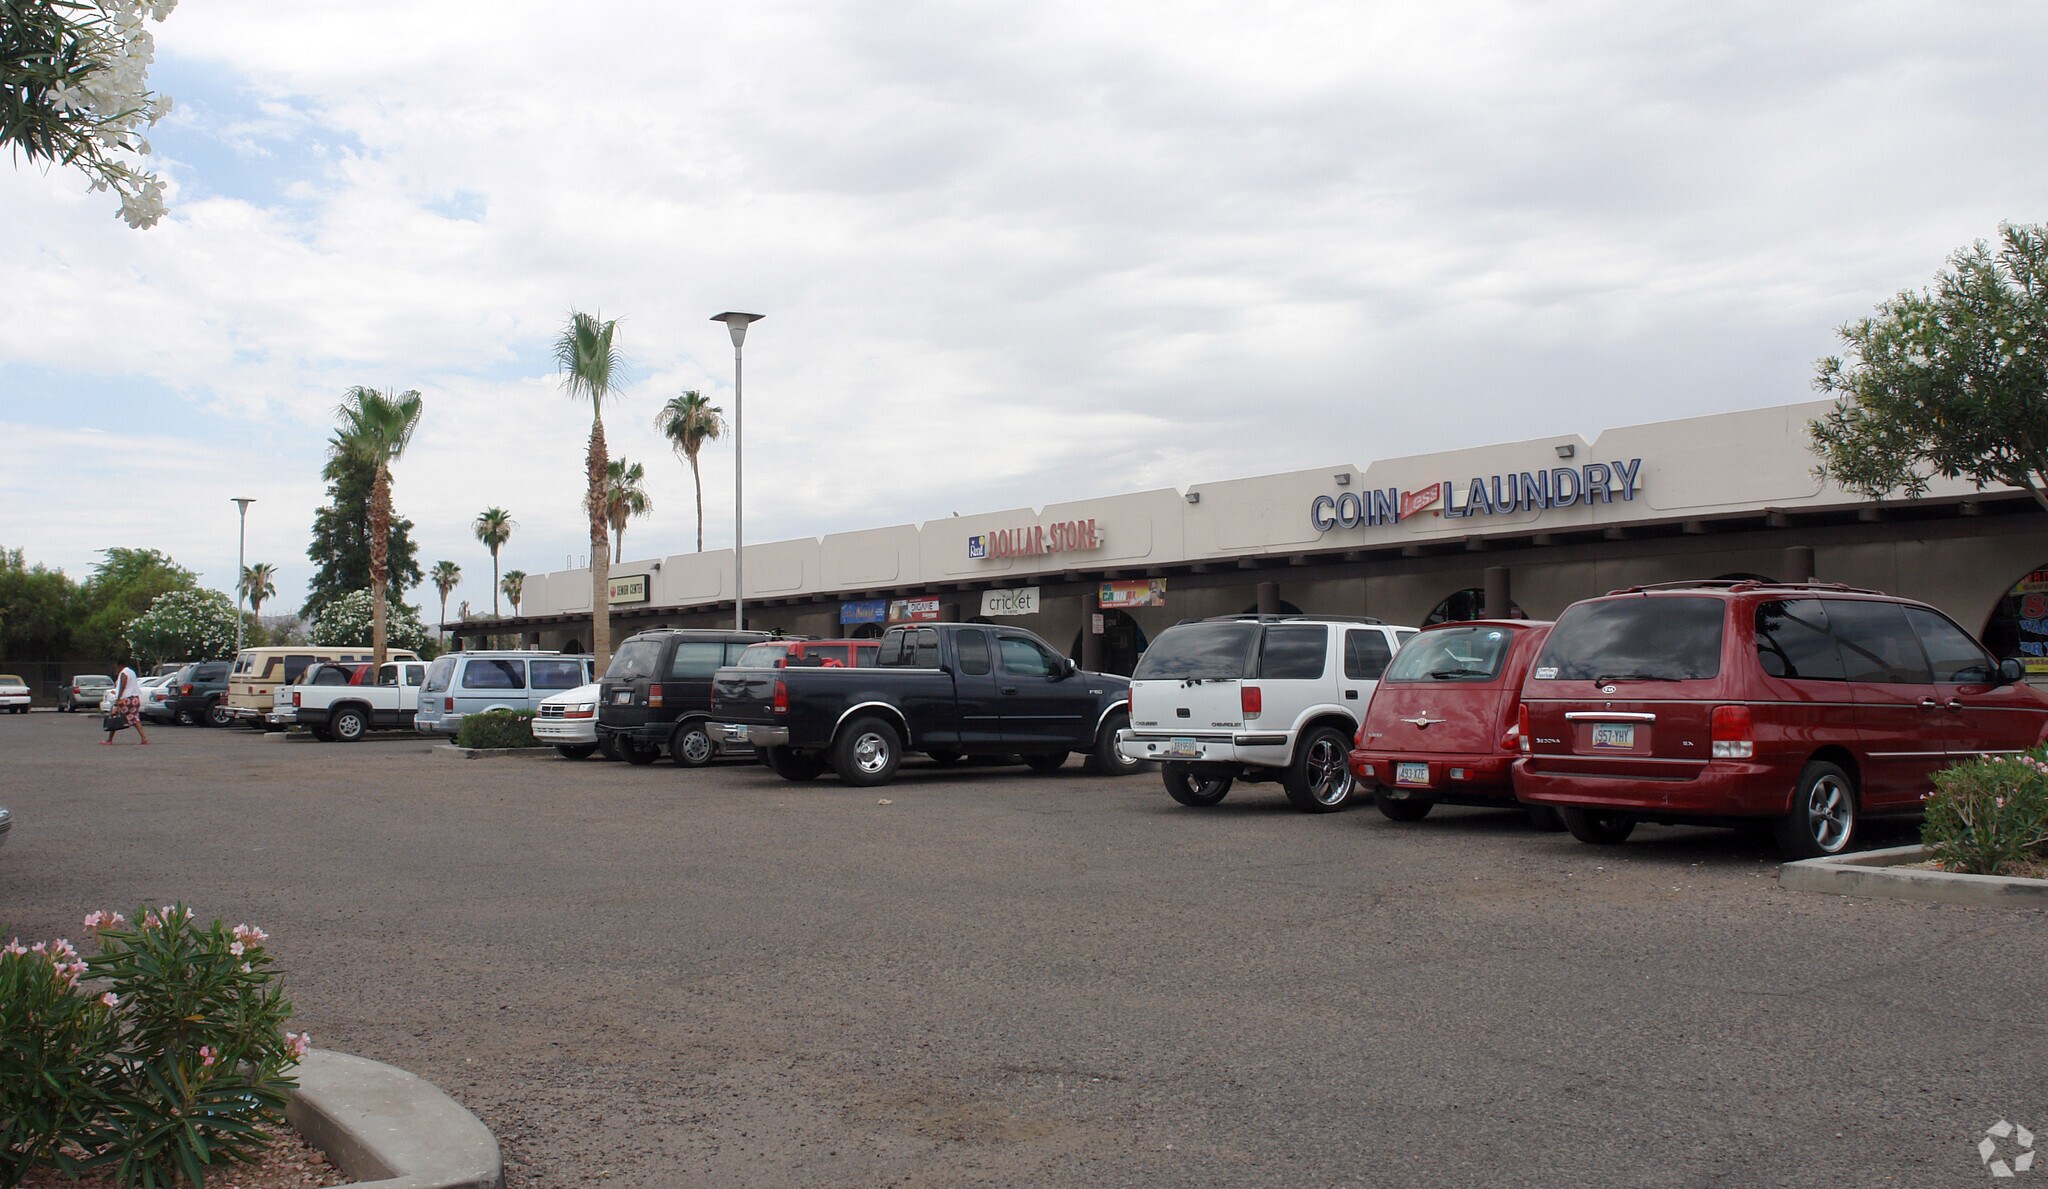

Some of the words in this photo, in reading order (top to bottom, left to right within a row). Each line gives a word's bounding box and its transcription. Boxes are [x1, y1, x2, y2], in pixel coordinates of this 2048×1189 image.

[1311, 487, 1398, 531] COIN
[1403, 485, 1438, 515] Less
[1443, 458, 1641, 519] LAUNDRY
[988, 525, 1045, 560] DOLLAR
[1049, 518, 1096, 553] STORE
[989, 589, 1031, 610] cricket
[2021, 593, 2048, 620] 8
[1597, 729, 1630, 744] 957-YHY
